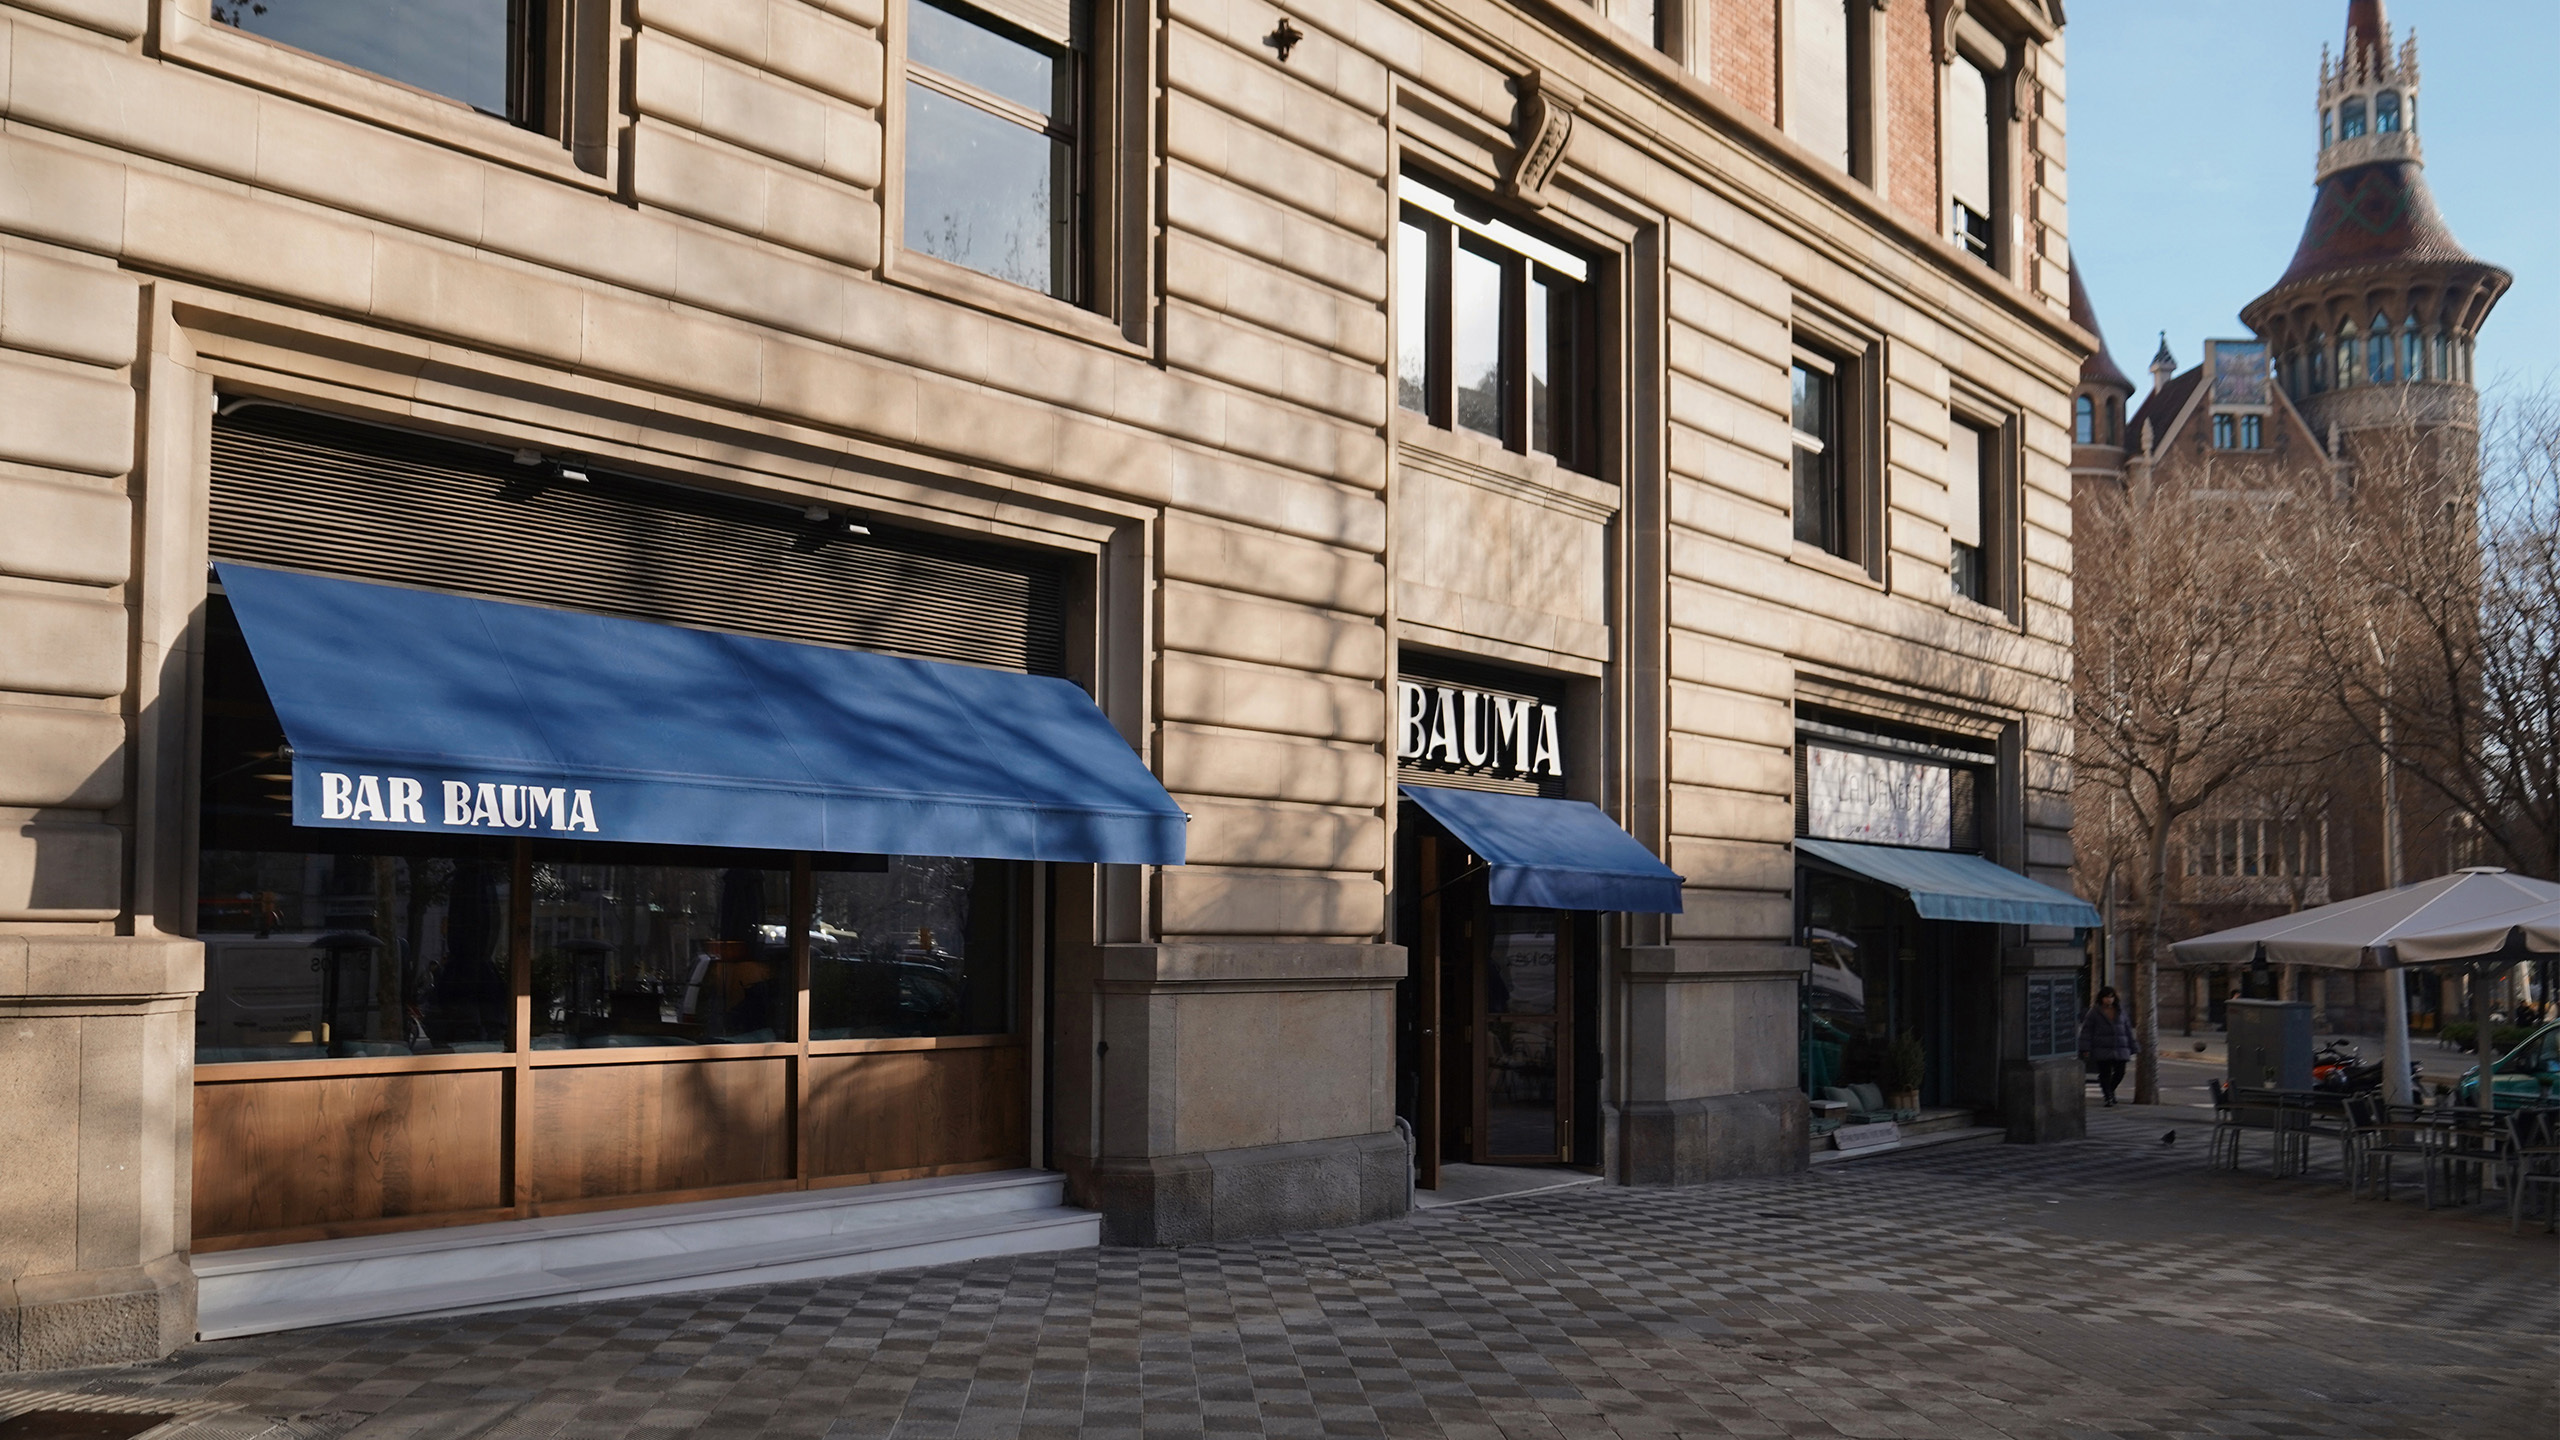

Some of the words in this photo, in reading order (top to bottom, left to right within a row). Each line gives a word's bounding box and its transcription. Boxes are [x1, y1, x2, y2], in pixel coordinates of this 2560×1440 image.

[1398, 681, 1562, 776] BAUMA
[320, 772, 426, 824] BAR
[442, 780, 600, 833] BAUMA
